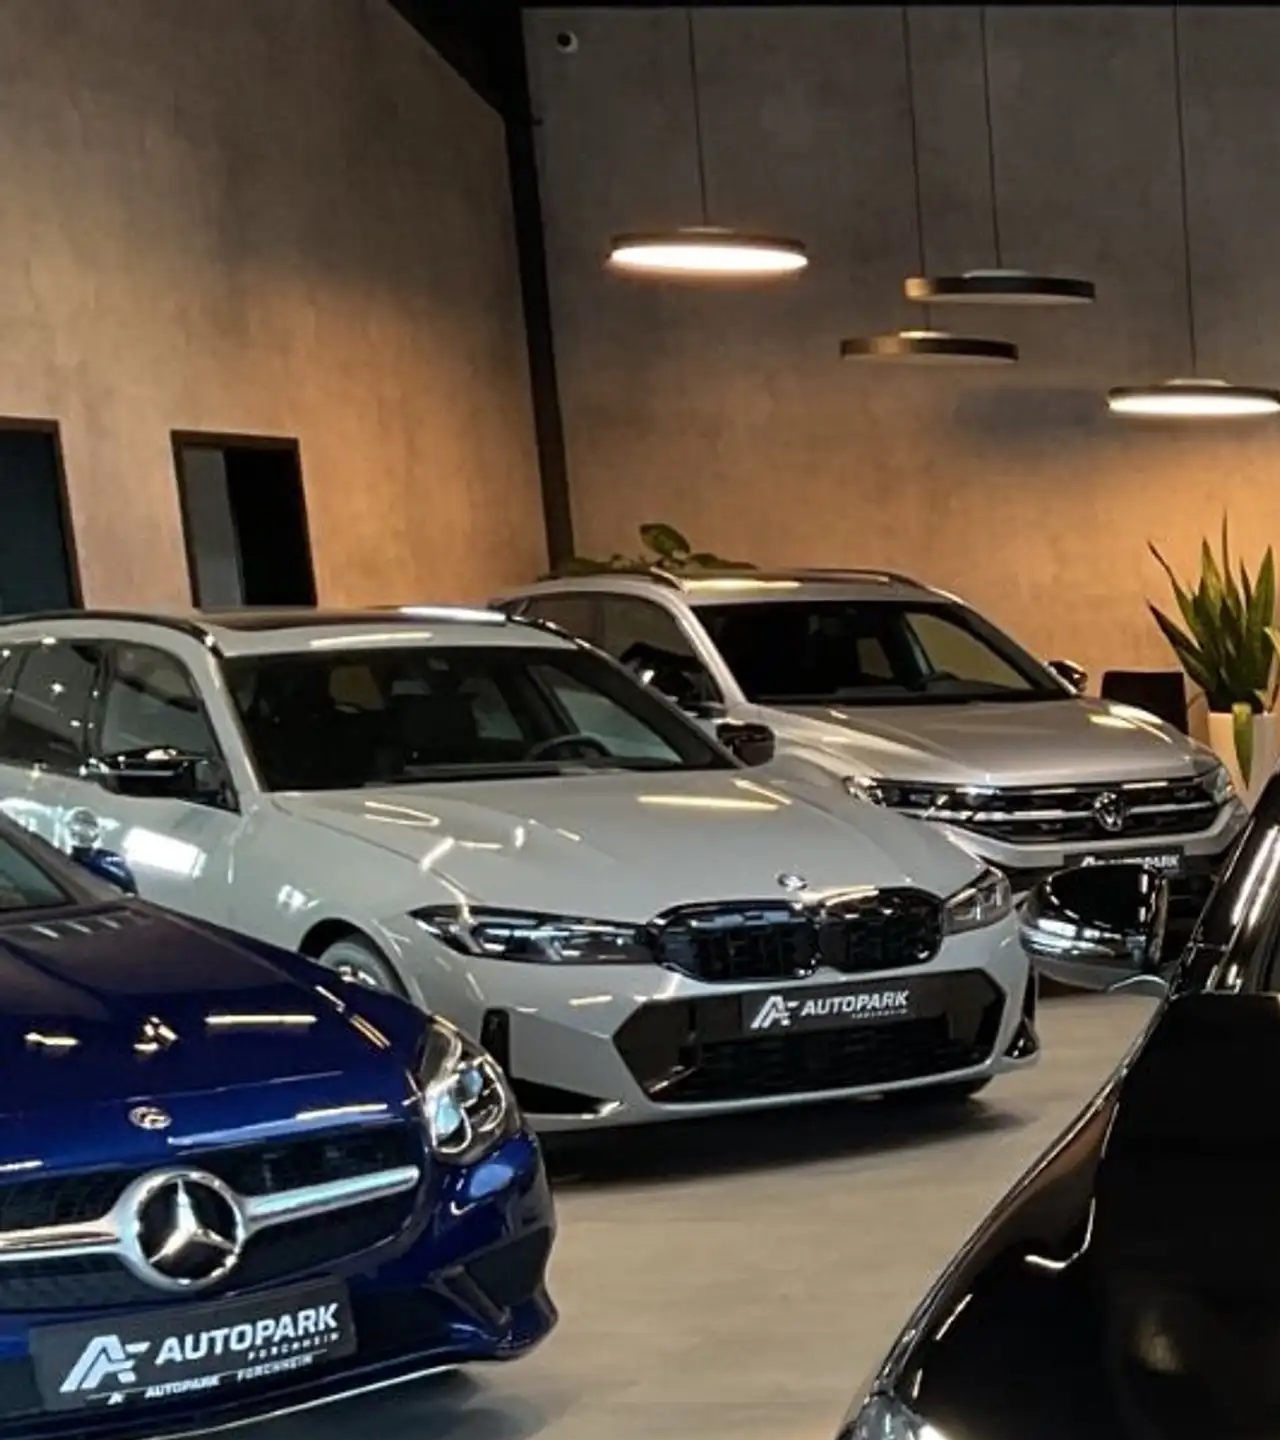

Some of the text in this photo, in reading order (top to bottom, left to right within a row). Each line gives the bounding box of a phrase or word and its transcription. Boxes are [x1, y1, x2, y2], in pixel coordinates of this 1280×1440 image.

[801, 990, 909, 1017] AUTOPARK
[155, 1303, 339, 1366] AUTOPARK
[145, 1374, 221, 1399] AUTOPARK
